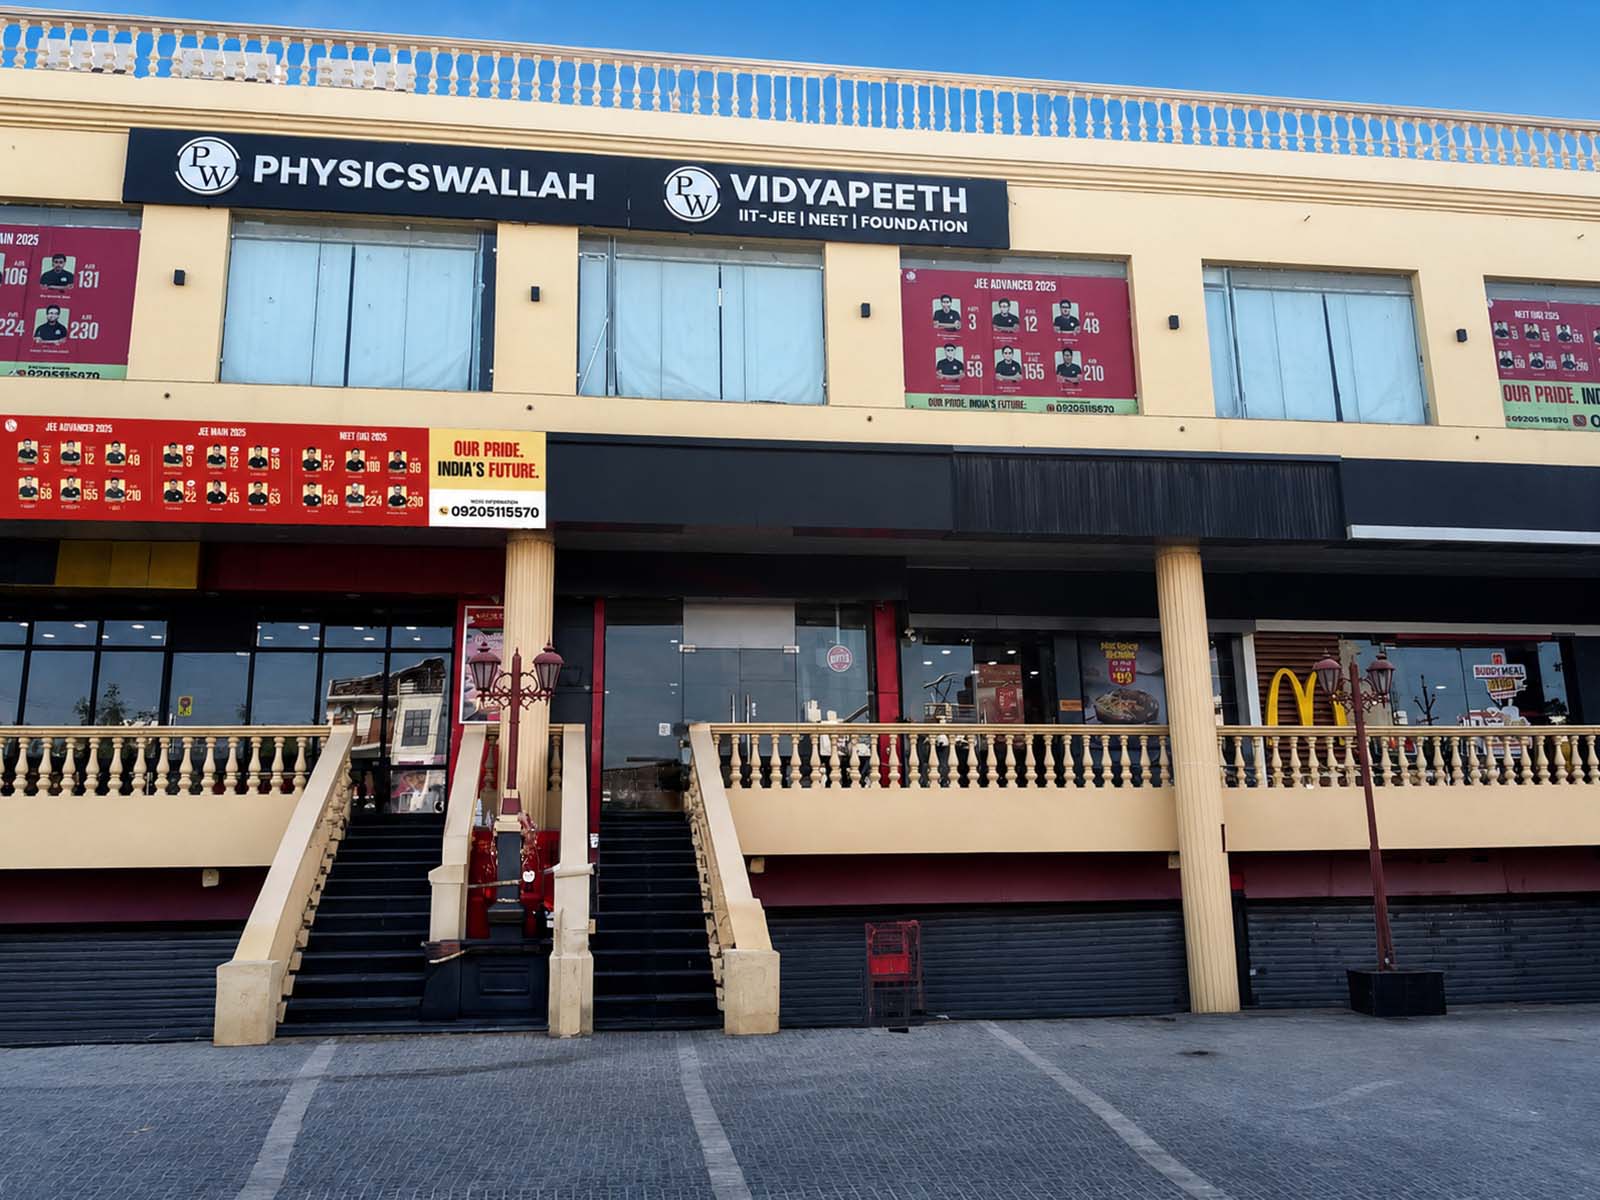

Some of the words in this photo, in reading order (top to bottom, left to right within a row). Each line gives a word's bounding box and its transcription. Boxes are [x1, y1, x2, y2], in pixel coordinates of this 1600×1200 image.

[253, 154, 595, 201] PHYSICSWALLAH
[730, 173, 967, 214] VIDYAPEETH
[738, 209, 796, 226] IIT-JEE
[808, 212, 848, 228] NEET
[861, 216, 968, 234] FOUNDATION
[16, 233, 39, 246] 2025
[4, 267, 28, 286] 106
[78, 270, 100, 289] 131
[974, 278, 989, 289] JEE
[990, 279, 1033, 290] ADVANCED
[1035, 281, 1056, 292] 2025
[968, 313, 977, 330] 3
[1024, 315, 1038, 332] 12
[1083, 317, 1100, 334] 48
[69, 322, 99, 341] 230
[967, 361, 983, 378] 58
[1024, 363, 1045, 381] 155
[1084, 365, 1104, 382] 210
[1503, 384, 1531, 402] OUR
[1535, 385, 1579, 404] PRIDE.
[45, 422, 57, 432] JEE
[59, 423, 94, 433] ADVANCED
[96, 424, 113, 433] 2025
[198, 427, 209, 436] JEE
[339, 431, 355, 440] NEET
[454, 440, 480, 457] OUR
[484, 442, 524, 459] PRIDE.
[85, 453, 95, 465] 12
[127, 454, 141, 468] 48
[229, 456, 239, 468] 12
[438, 461, 484, 477] INDIA'S
[488, 462, 540, 479] FUTURE.
[83, 488, 99, 501] 155
[126, 490, 142, 502] 210
[185, 491, 197, 503] 22
[227, 492, 239, 504] 45
[365, 495, 382, 507] 224
[451, 505, 540, 518] 09205115570
[1501, 666, 1524, 675] MEAL
